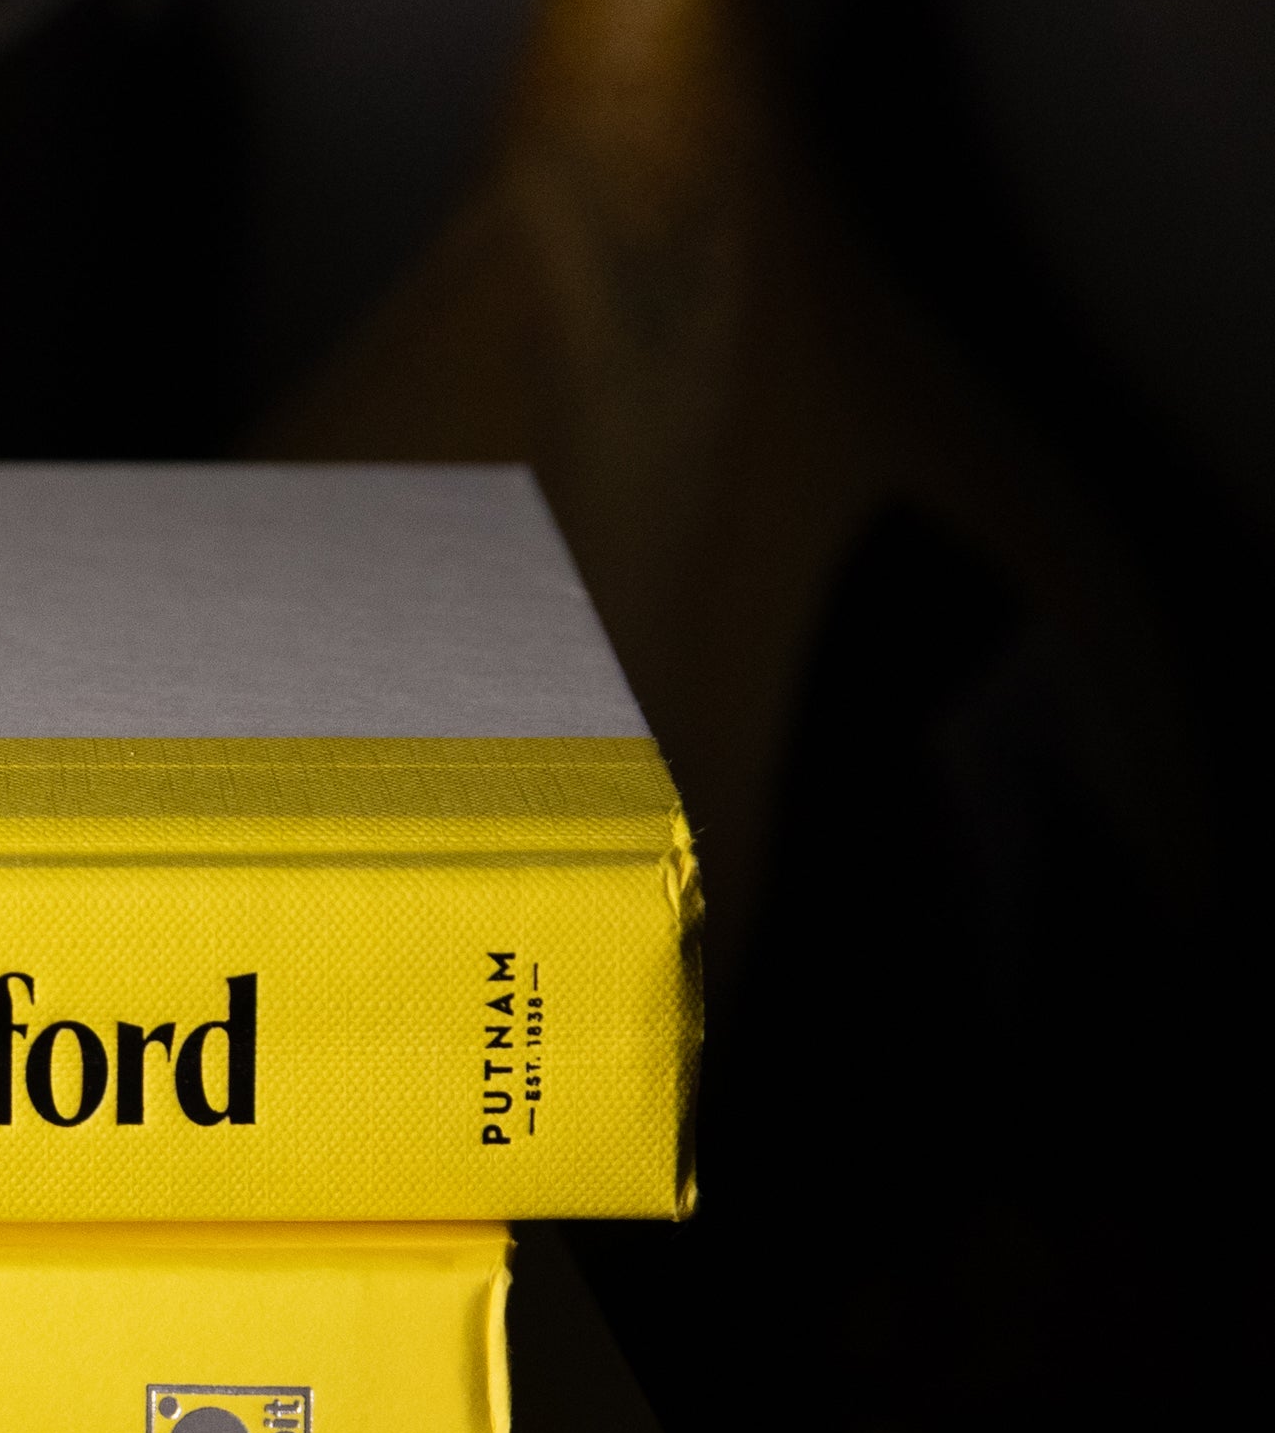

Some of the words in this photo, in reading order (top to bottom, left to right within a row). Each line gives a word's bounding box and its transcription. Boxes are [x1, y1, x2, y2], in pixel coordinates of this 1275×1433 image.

[526, 997, 543, 1047] 1838
[482, 953, 516, 1145] PUTNAM
[525, 1057, 541, 1101] EST.
